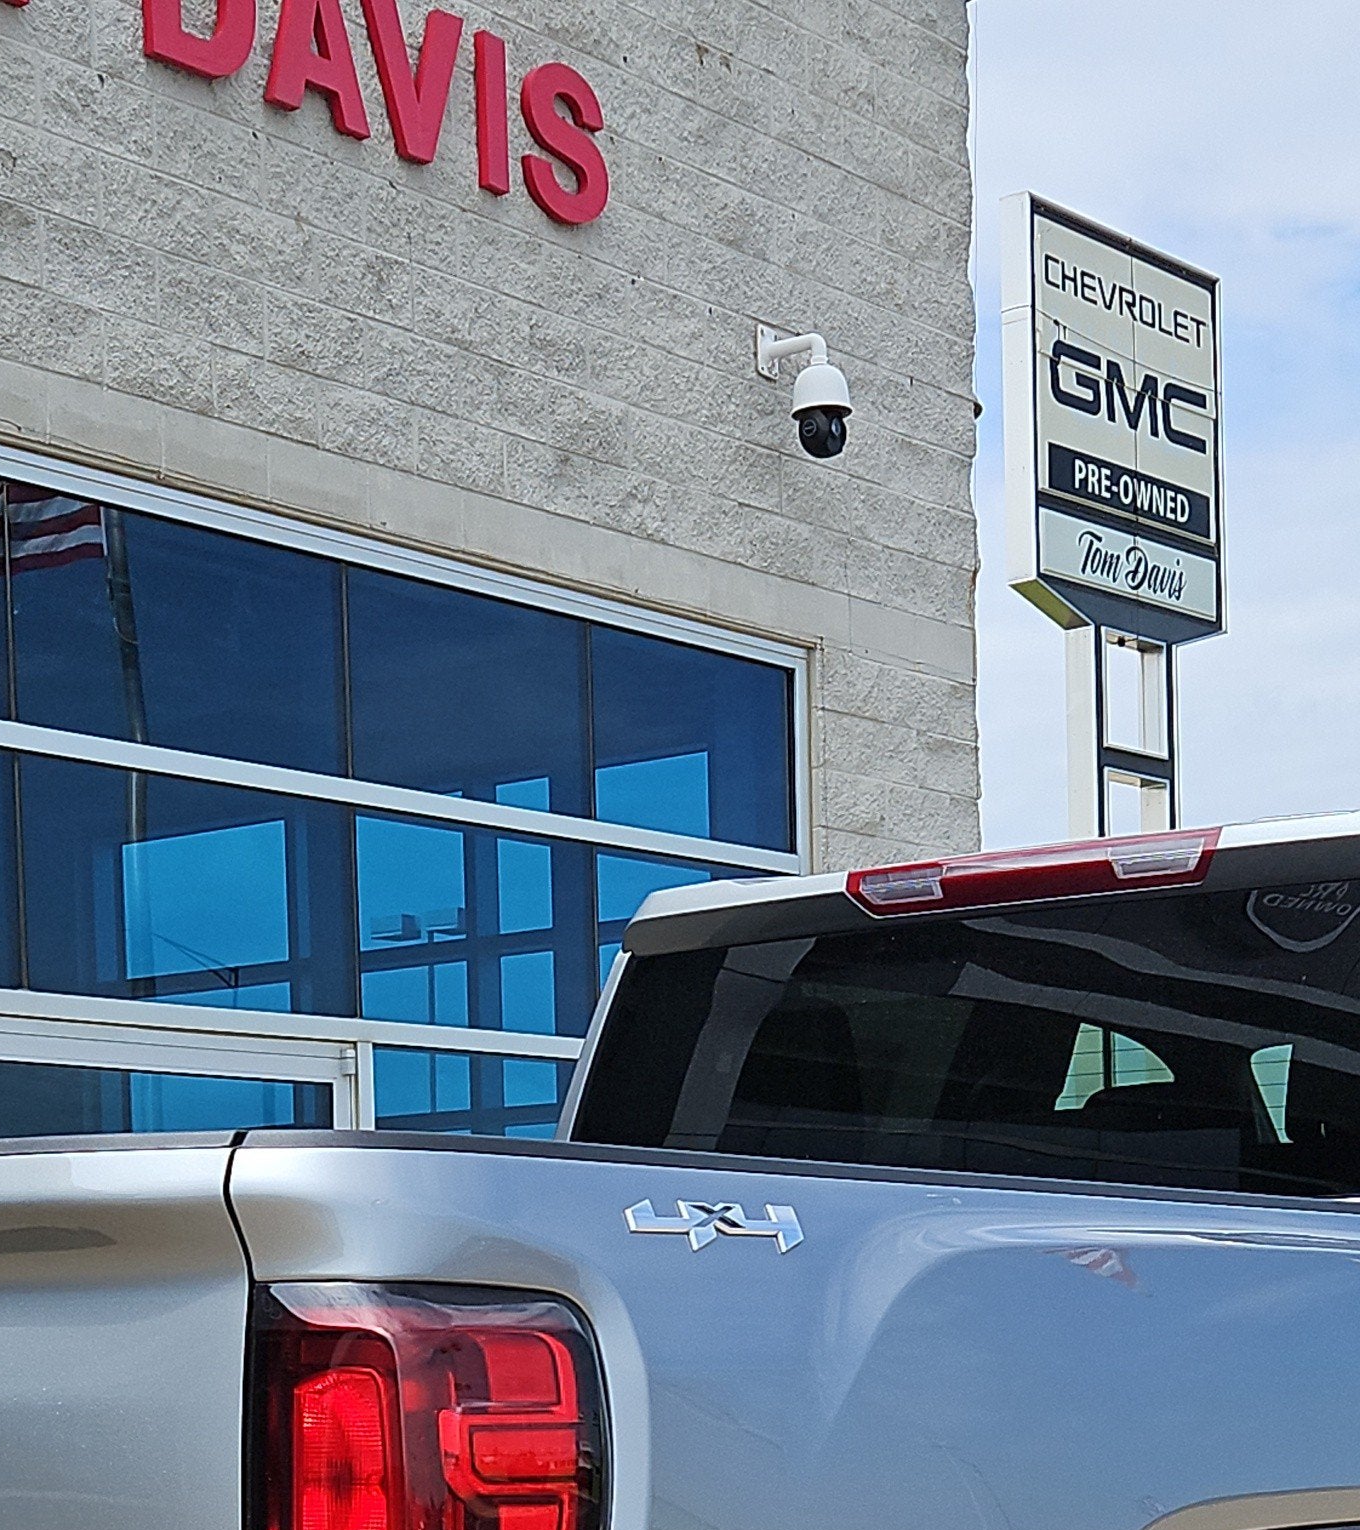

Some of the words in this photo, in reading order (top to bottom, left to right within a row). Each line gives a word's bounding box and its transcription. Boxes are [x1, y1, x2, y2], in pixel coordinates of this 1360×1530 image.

[1043, 253, 1207, 348] CHEVROLET
[1050, 339, 1208, 456] GMC
[1074, 457, 1190, 523] PRE-OWNED
[1078, 530, 1123, 584] Tom
[1124, 545, 1187, 601] Davis
